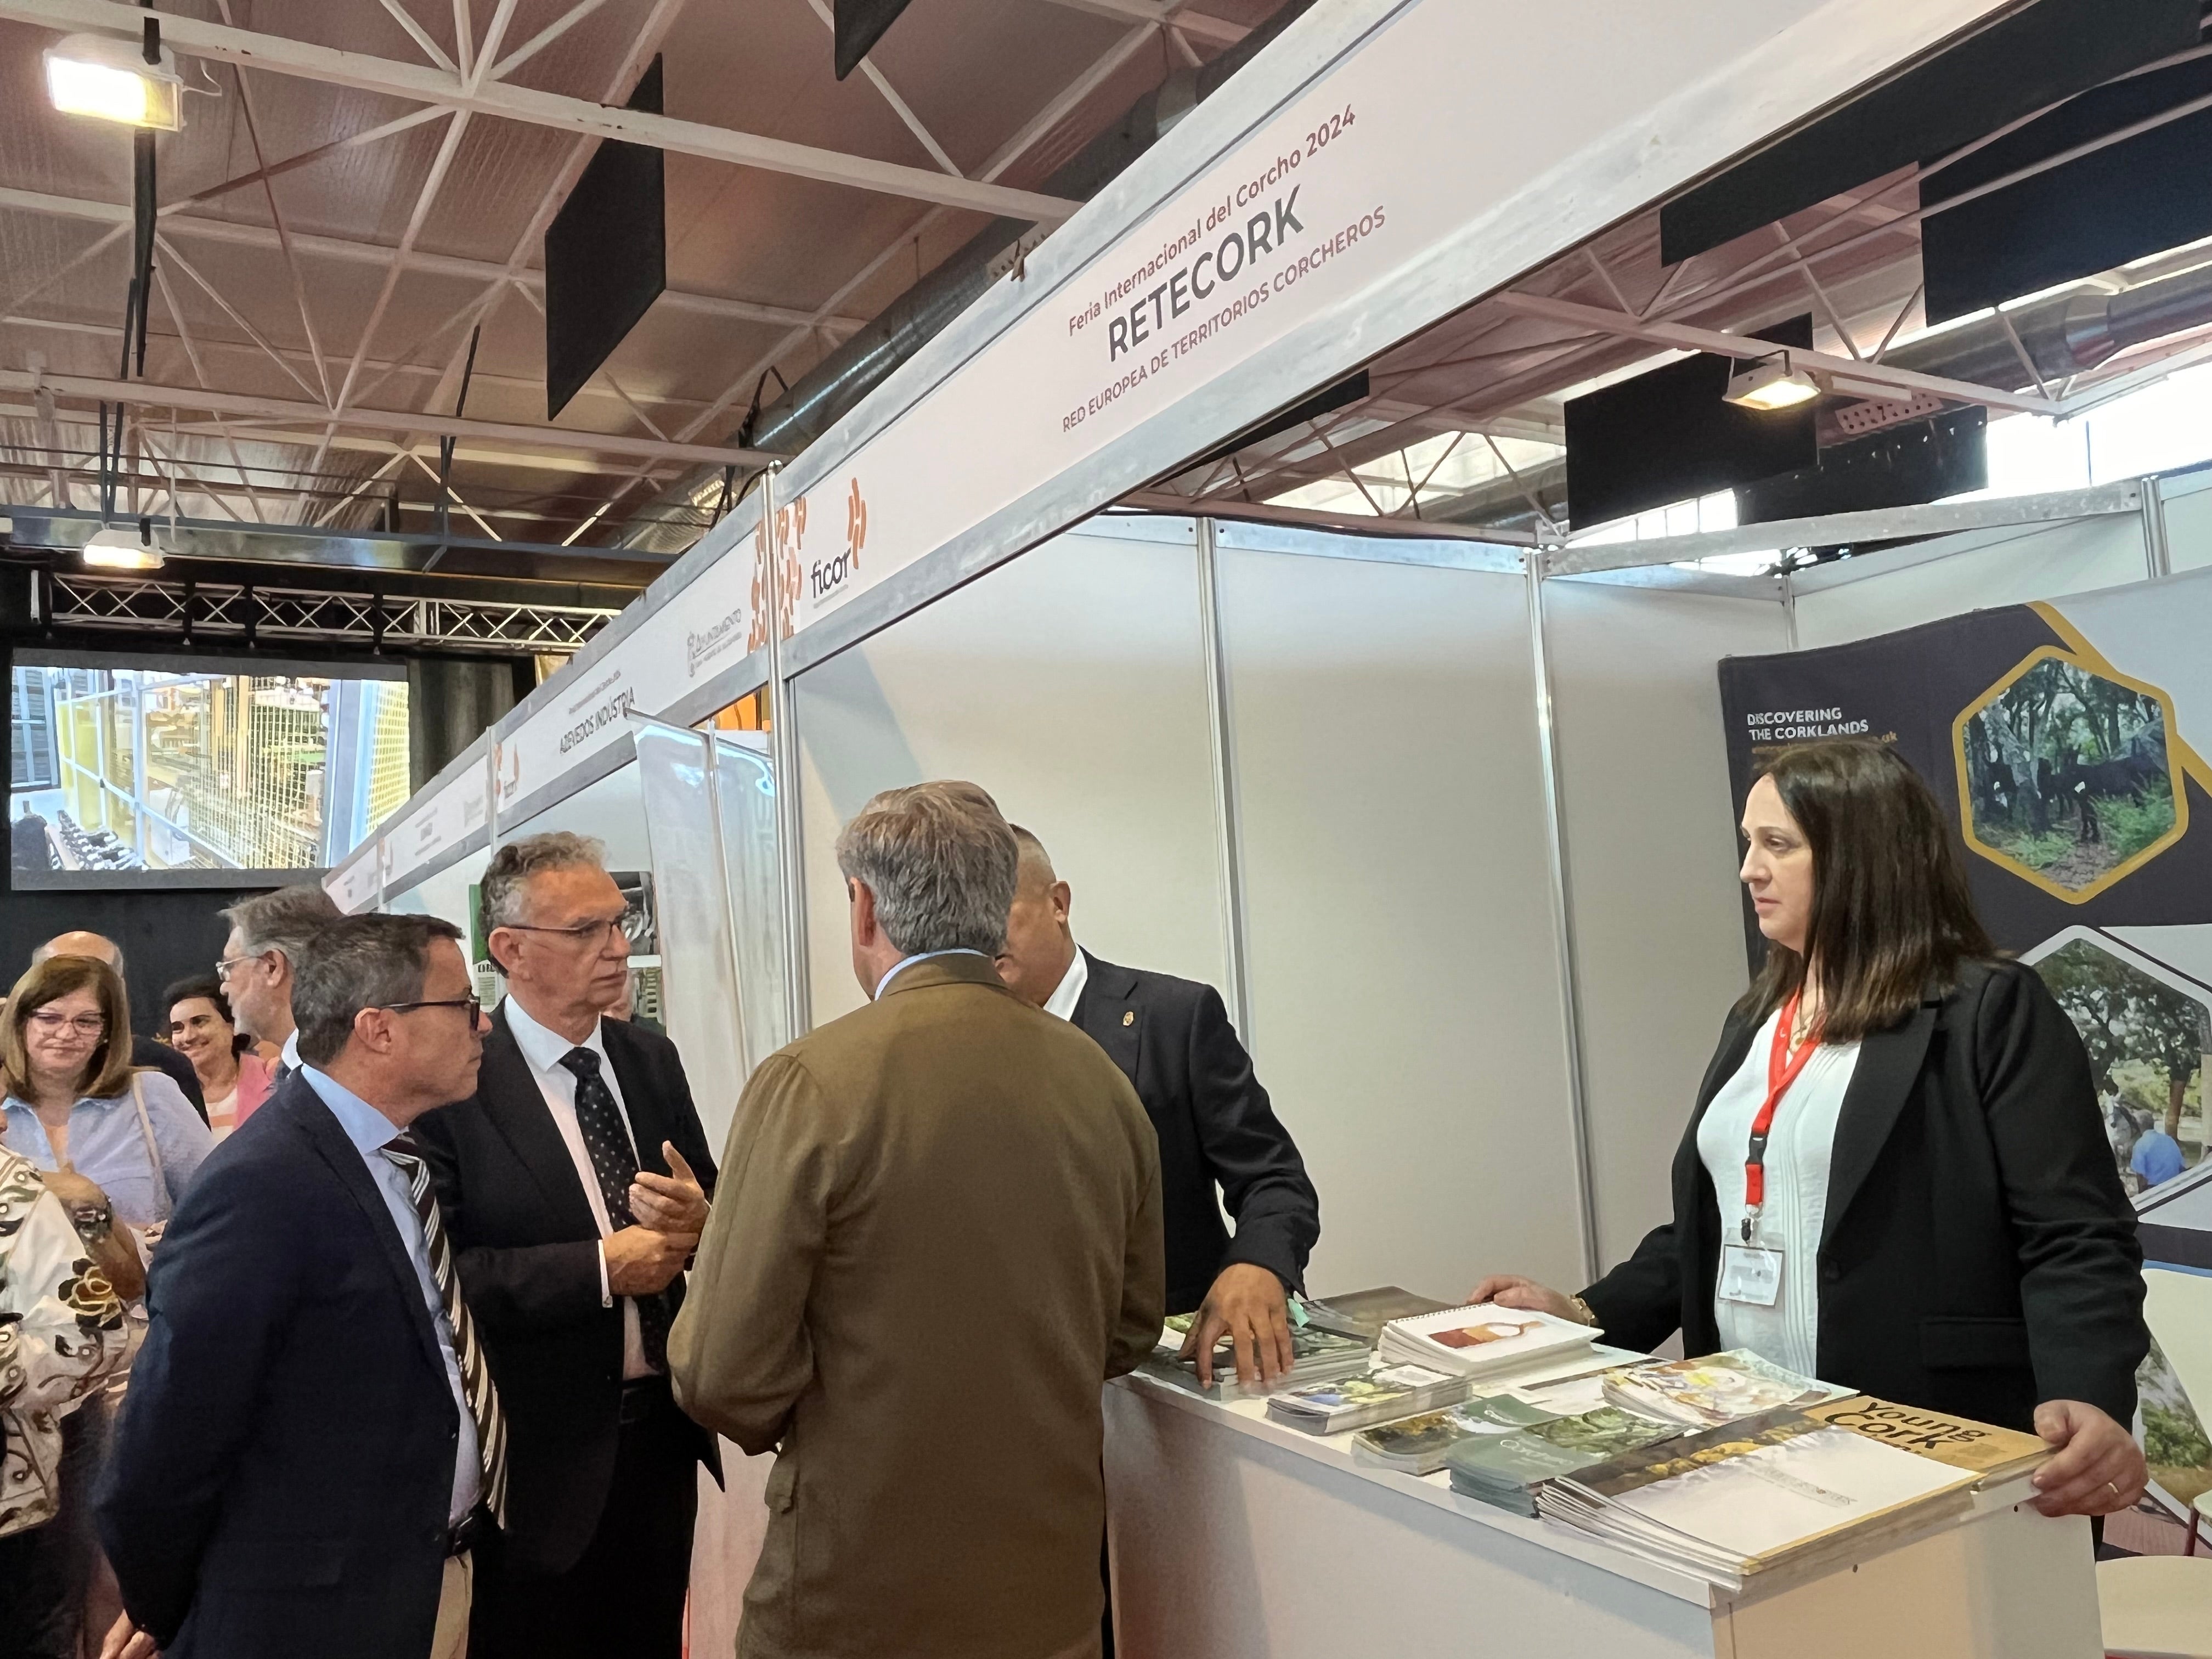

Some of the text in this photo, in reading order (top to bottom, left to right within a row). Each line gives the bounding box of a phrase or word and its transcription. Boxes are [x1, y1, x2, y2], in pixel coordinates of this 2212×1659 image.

[1069, 104, 1356, 336] Feria Internacional del Corcho 2024
[1109, 184, 1304, 362] RETECORK
[1063, 206, 1385, 432] RED EUROPEA DE TERRITORIOS CORCHEROS
[811, 547, 851, 599] ficor
[1747, 707, 1842, 726] DISCOVERING
[1748, 728, 1771, 741] THE
[1775, 719, 1870, 740] CORKLANDS
[1859, 1402, 1993, 1442] Young
